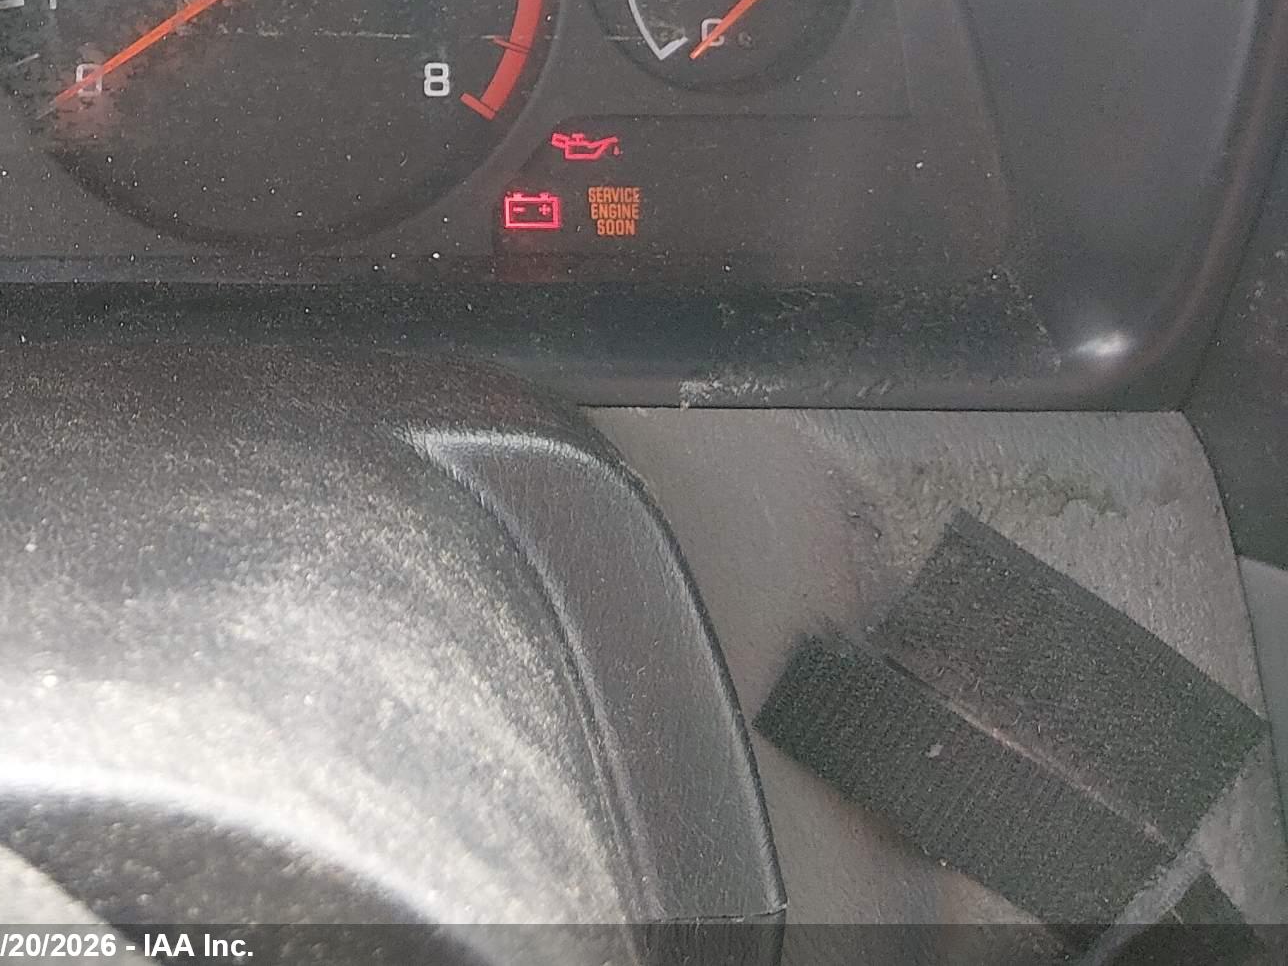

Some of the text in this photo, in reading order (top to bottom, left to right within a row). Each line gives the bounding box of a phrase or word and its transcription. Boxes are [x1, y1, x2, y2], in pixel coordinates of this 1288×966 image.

[423, 62, 450, 97] 8
[588, 187, 641, 203] SERVICE
[591, 204, 640, 220] ENGINE
[597, 219, 635, 235] SOON
